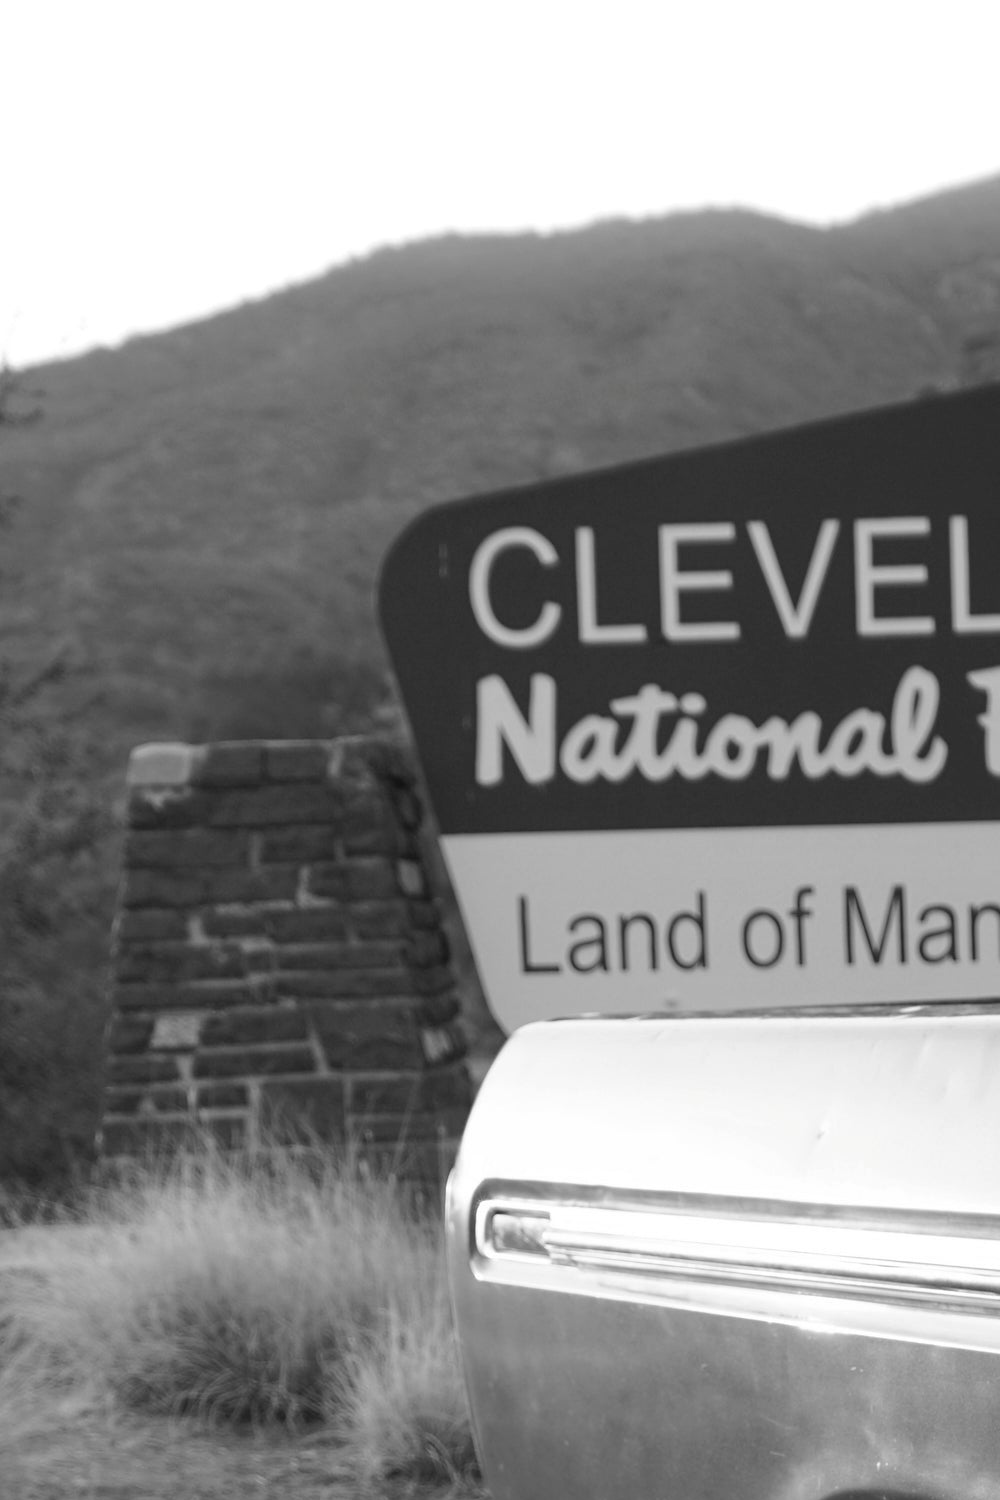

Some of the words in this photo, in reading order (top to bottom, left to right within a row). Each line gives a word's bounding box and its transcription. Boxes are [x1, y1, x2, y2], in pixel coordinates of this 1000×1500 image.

[475, 666, 948, 786] National
[518, 892, 707, 974] Land
[742, 887, 814, 968] of
